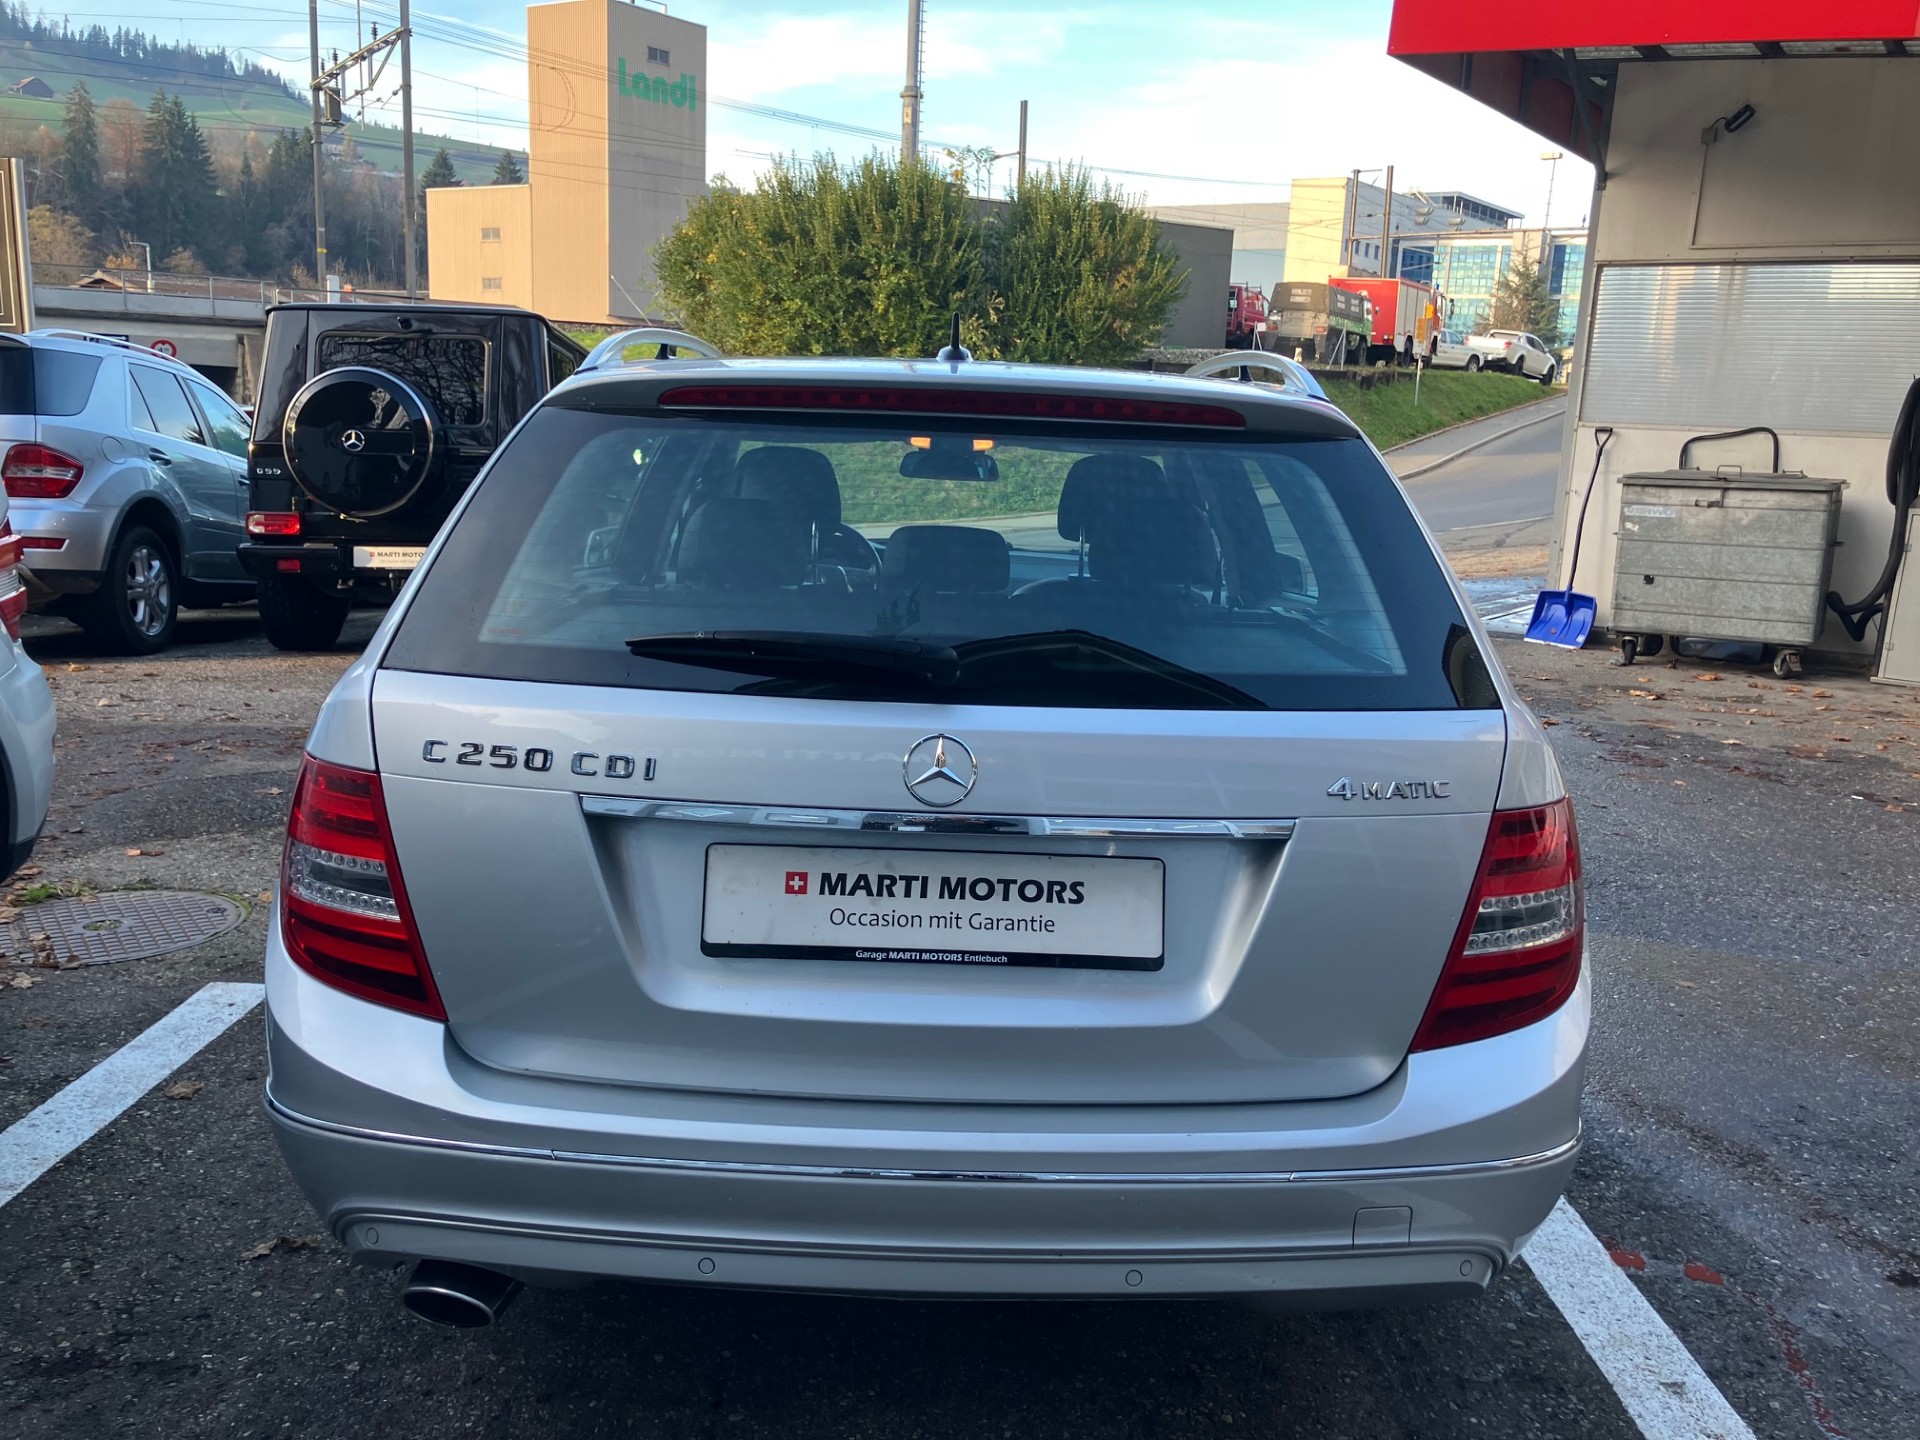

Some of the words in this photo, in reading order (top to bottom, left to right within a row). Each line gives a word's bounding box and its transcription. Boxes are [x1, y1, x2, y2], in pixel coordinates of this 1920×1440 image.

[618, 57, 696, 111] Landi
[570, 750, 657, 781] CDI
[818, 872, 929, 899] MARTI
[938, 876, 1085, 905] MOTORS
[829, 907, 923, 928] Occasion
[929, 911, 963, 930] mit
[968, 912, 1055, 933] Garantie
[855, 949, 888, 961] Garage
[888, 951, 920, 960] MARTI
[921, 952, 963, 962] MOTORS
[963, 953, 1008, 964] Entlebuch
